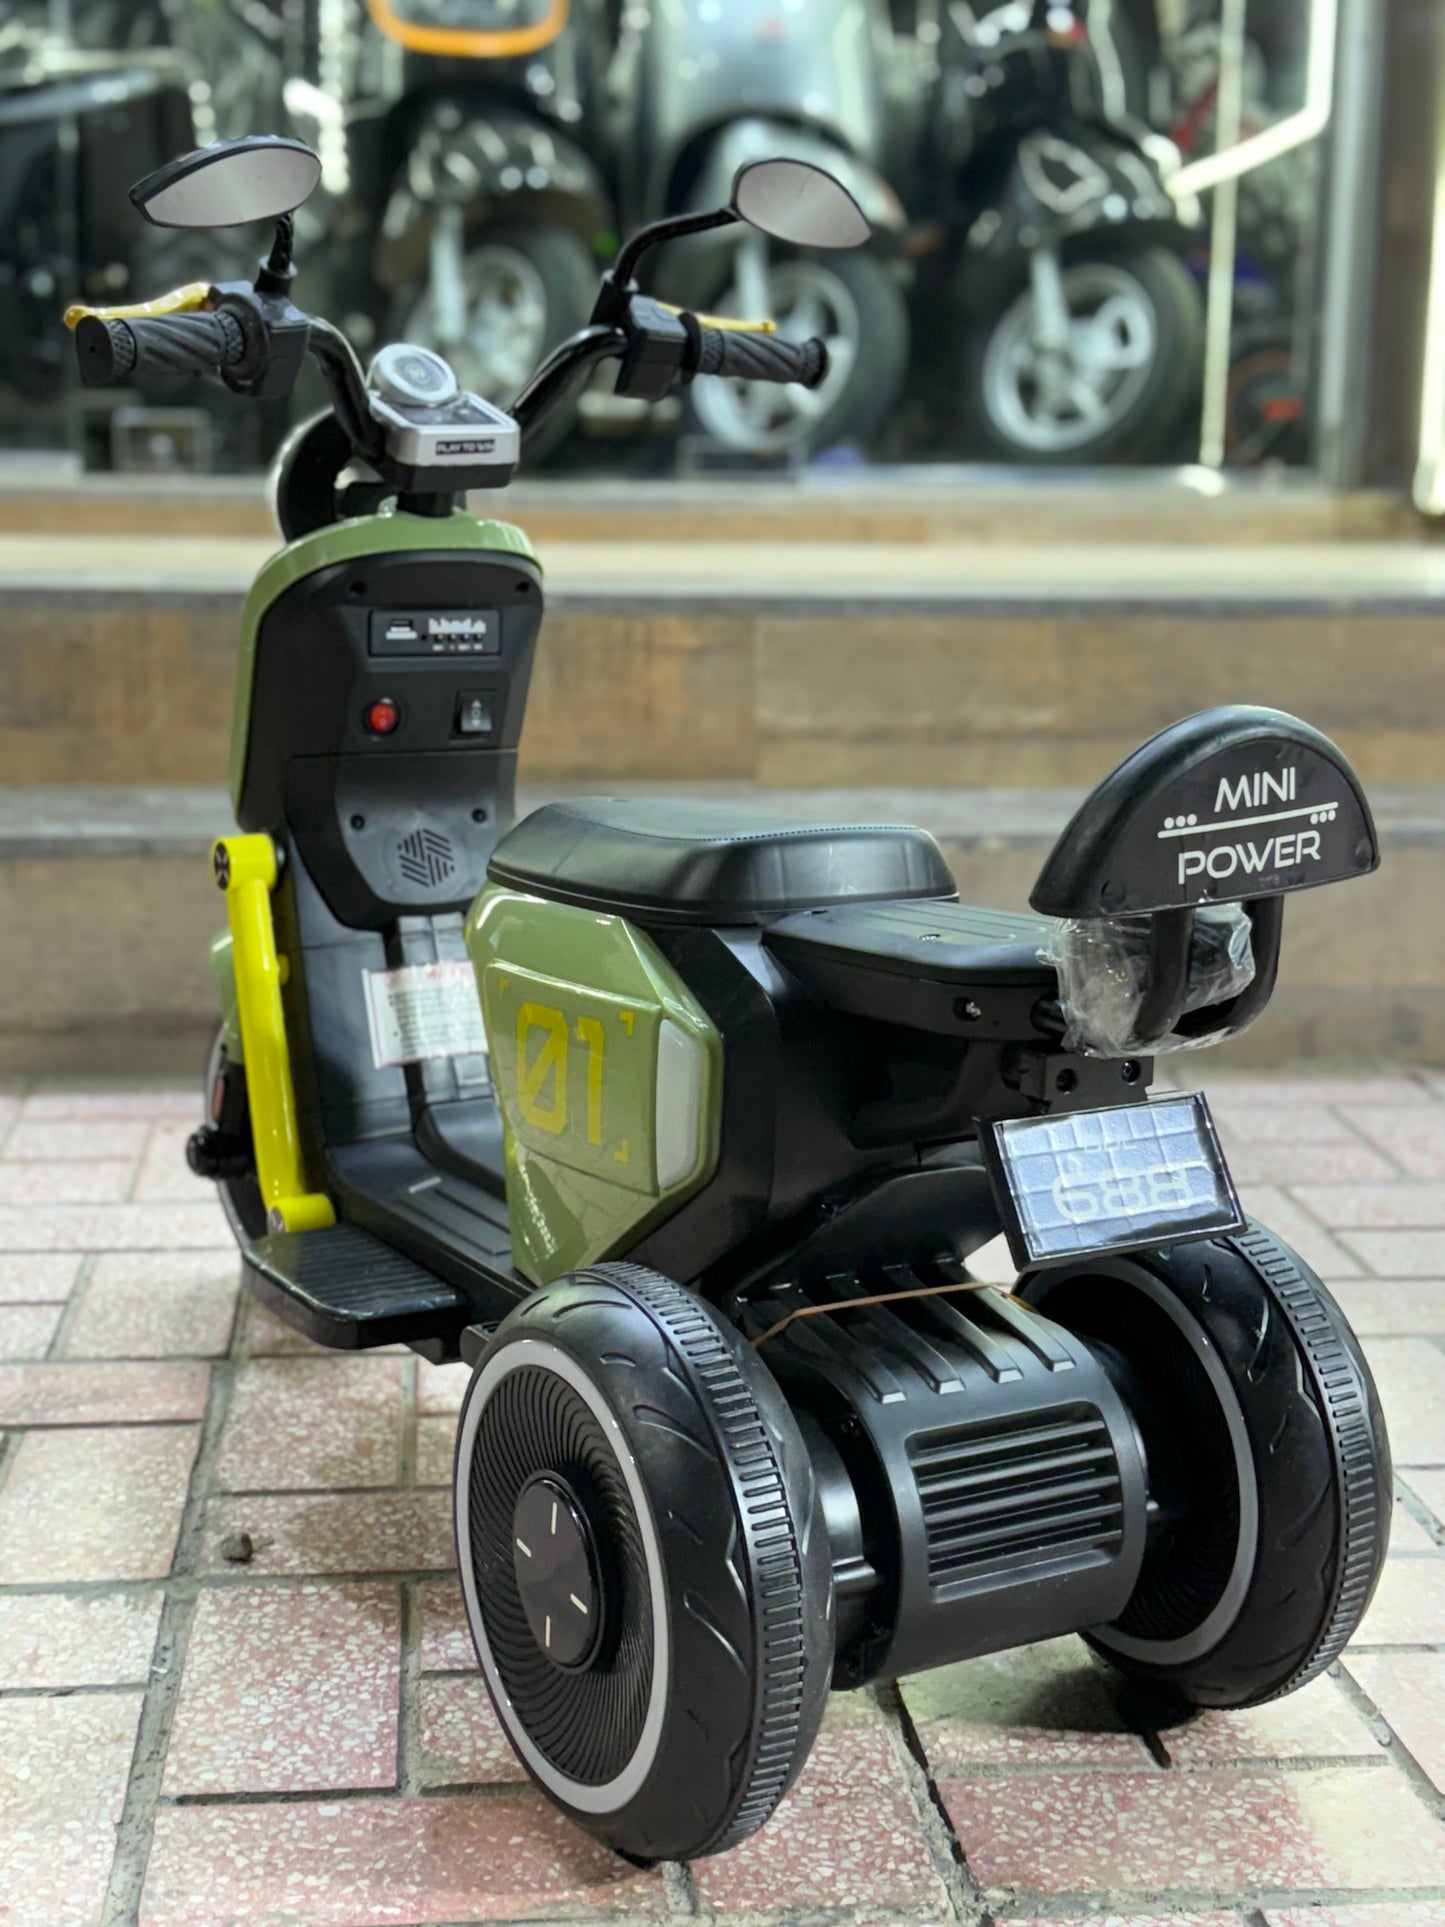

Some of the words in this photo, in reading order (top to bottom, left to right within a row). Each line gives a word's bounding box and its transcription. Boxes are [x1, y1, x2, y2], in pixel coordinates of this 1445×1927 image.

[1214, 767, 1296, 813] MINI
[1178, 830, 1321, 885] POWER
[516, 1001, 604, 1145] 01
[1051, 1164, 1194, 1223] 688
